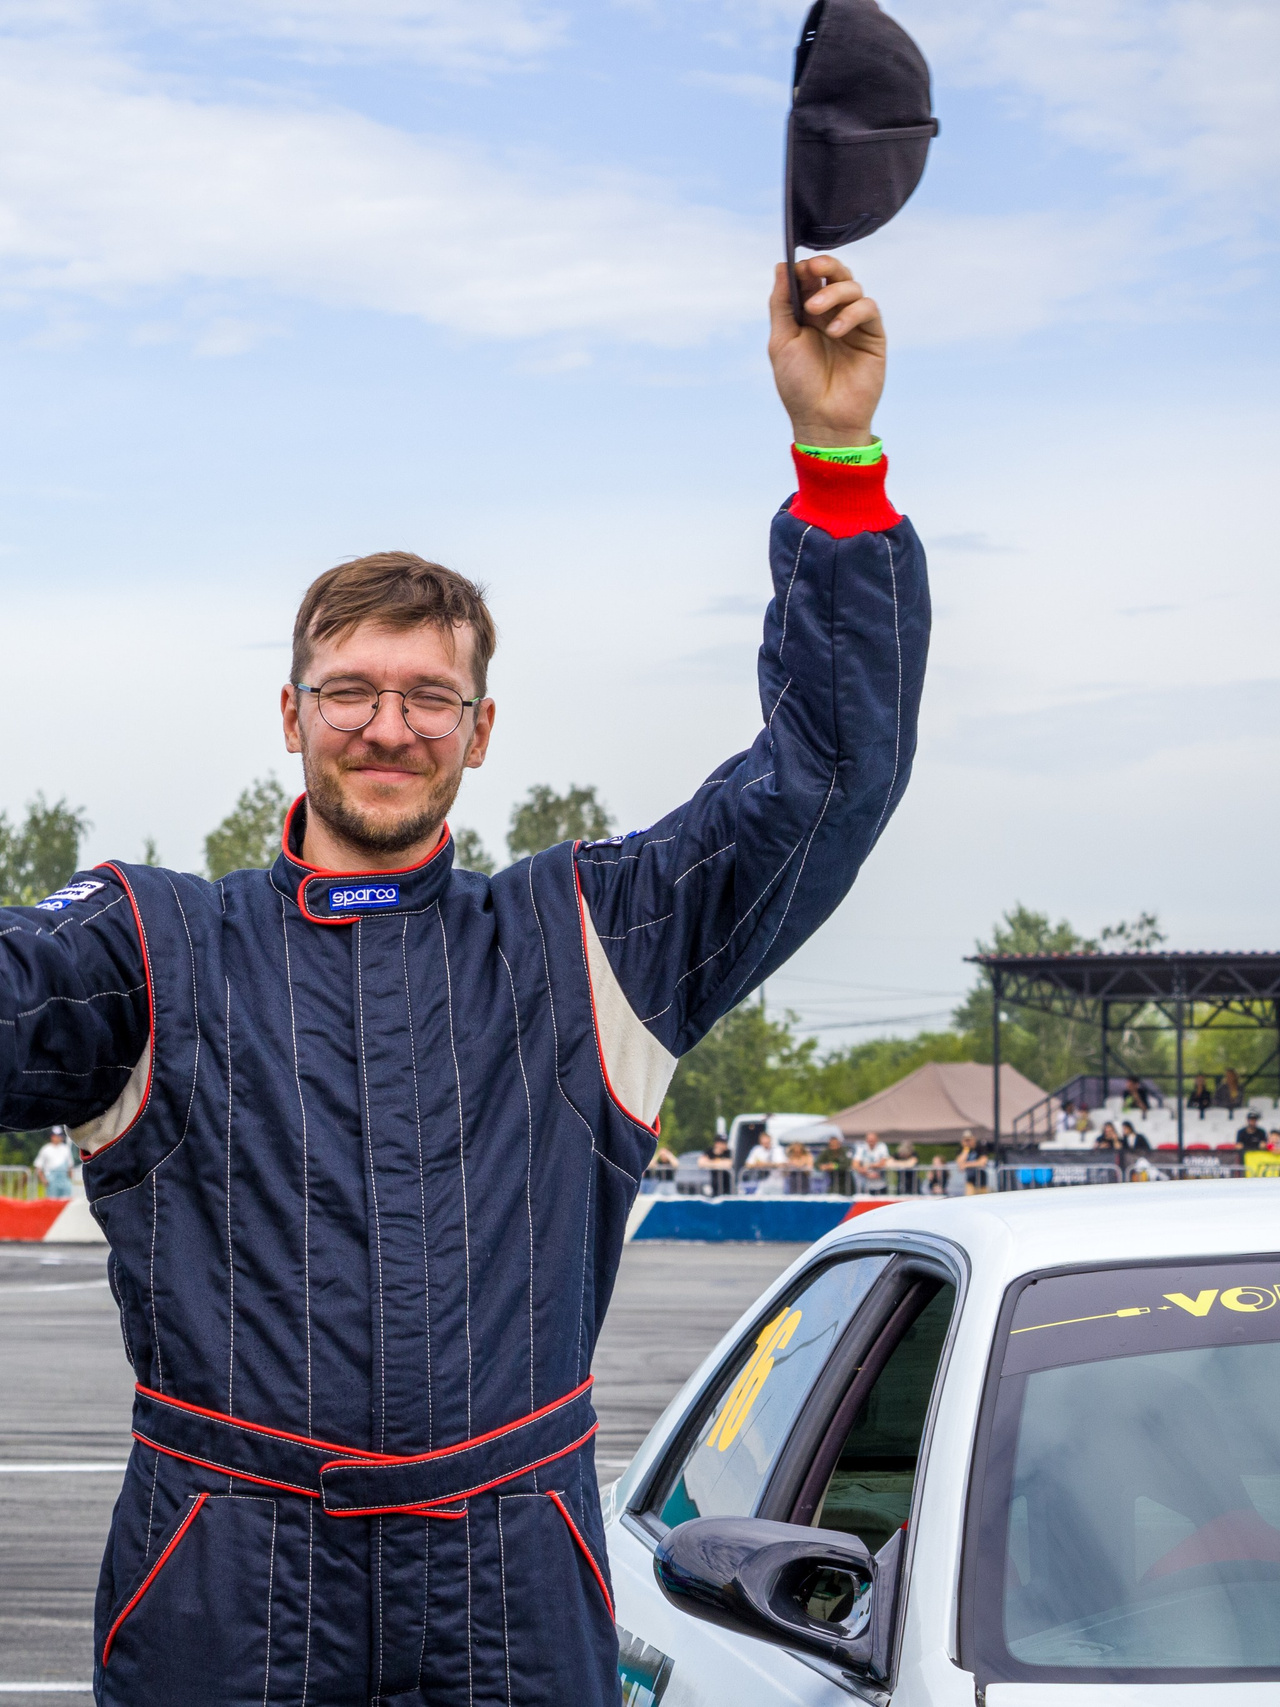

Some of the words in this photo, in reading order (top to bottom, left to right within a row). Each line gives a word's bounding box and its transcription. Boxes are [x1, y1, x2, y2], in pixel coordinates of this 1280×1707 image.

[332, 888, 396, 906] sparco
[1162, 1284, 1280, 1317] VO
[706, 1307, 802, 1452] 16
